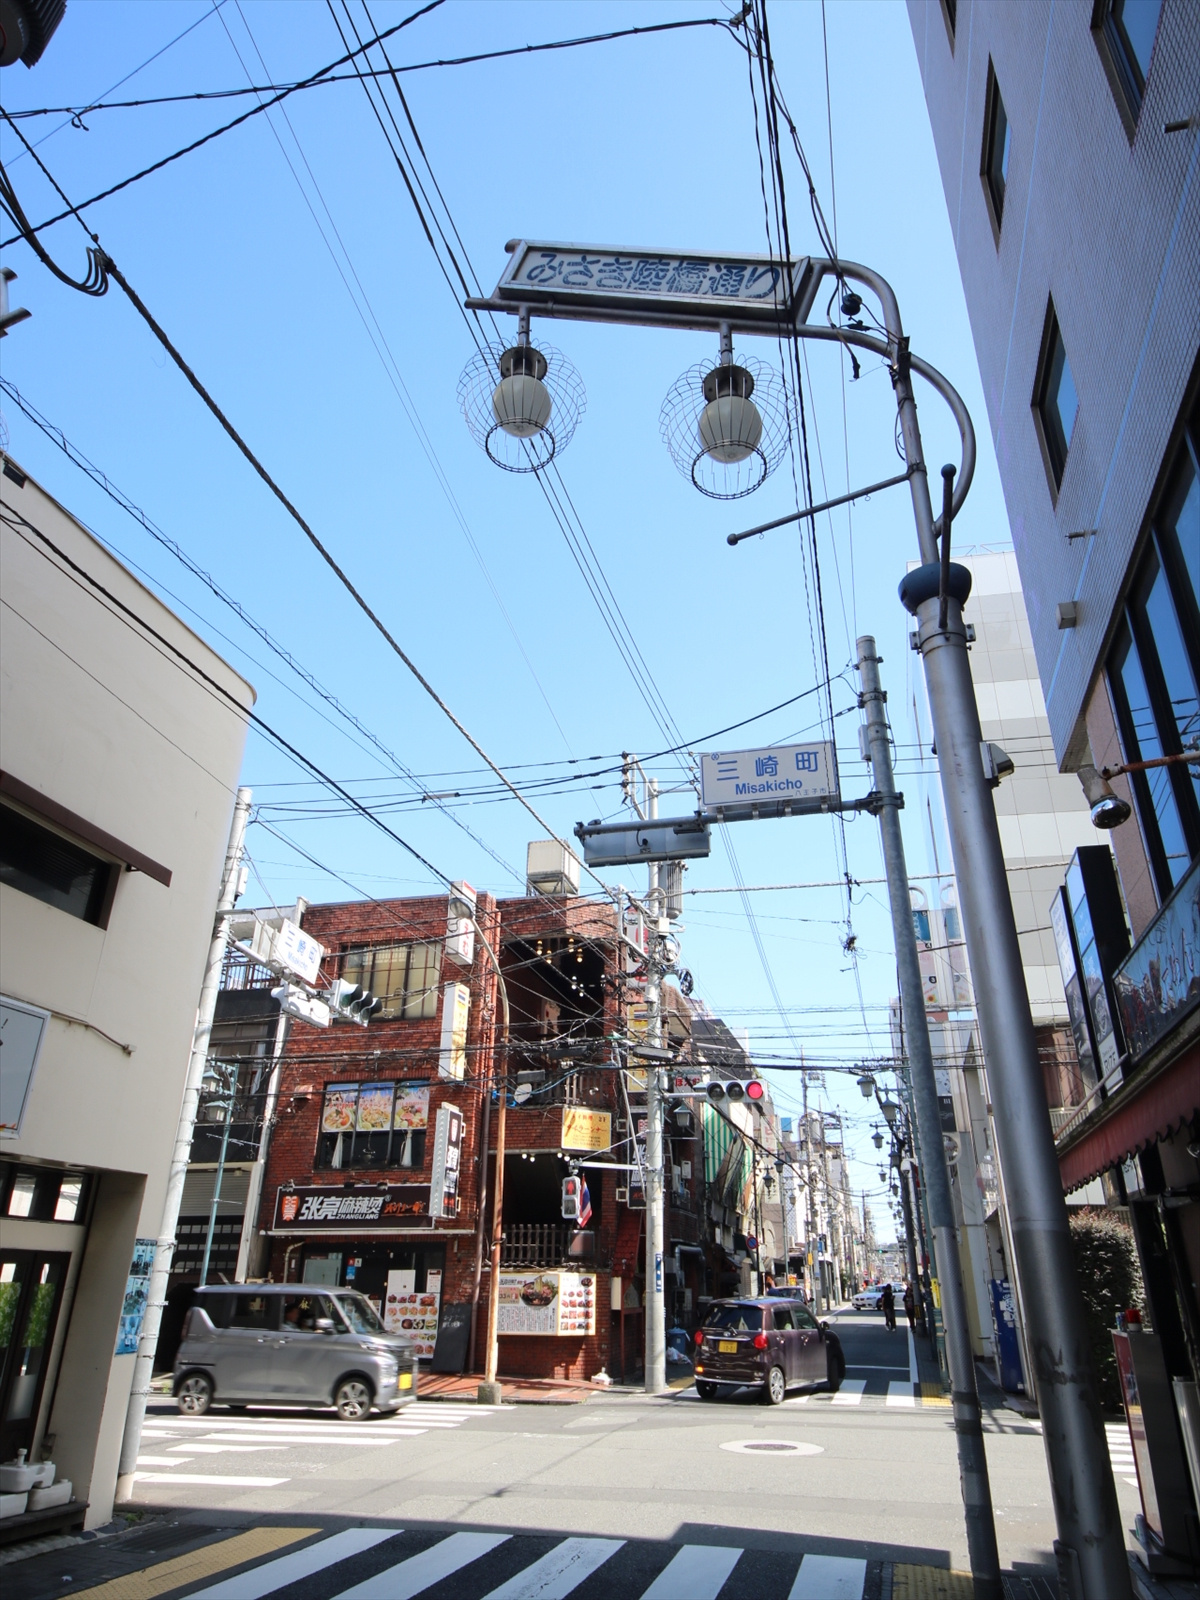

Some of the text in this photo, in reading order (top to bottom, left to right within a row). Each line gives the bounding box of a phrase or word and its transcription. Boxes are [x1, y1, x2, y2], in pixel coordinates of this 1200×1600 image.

[526, 252, 781, 299] みさき陸橋通り
[716, 751, 820, 782] 三崎町
[735, 778, 803, 795] Misakicho
[795, 788, 827, 797] 八王子市
[284, 930, 318, 964] 三崎町
